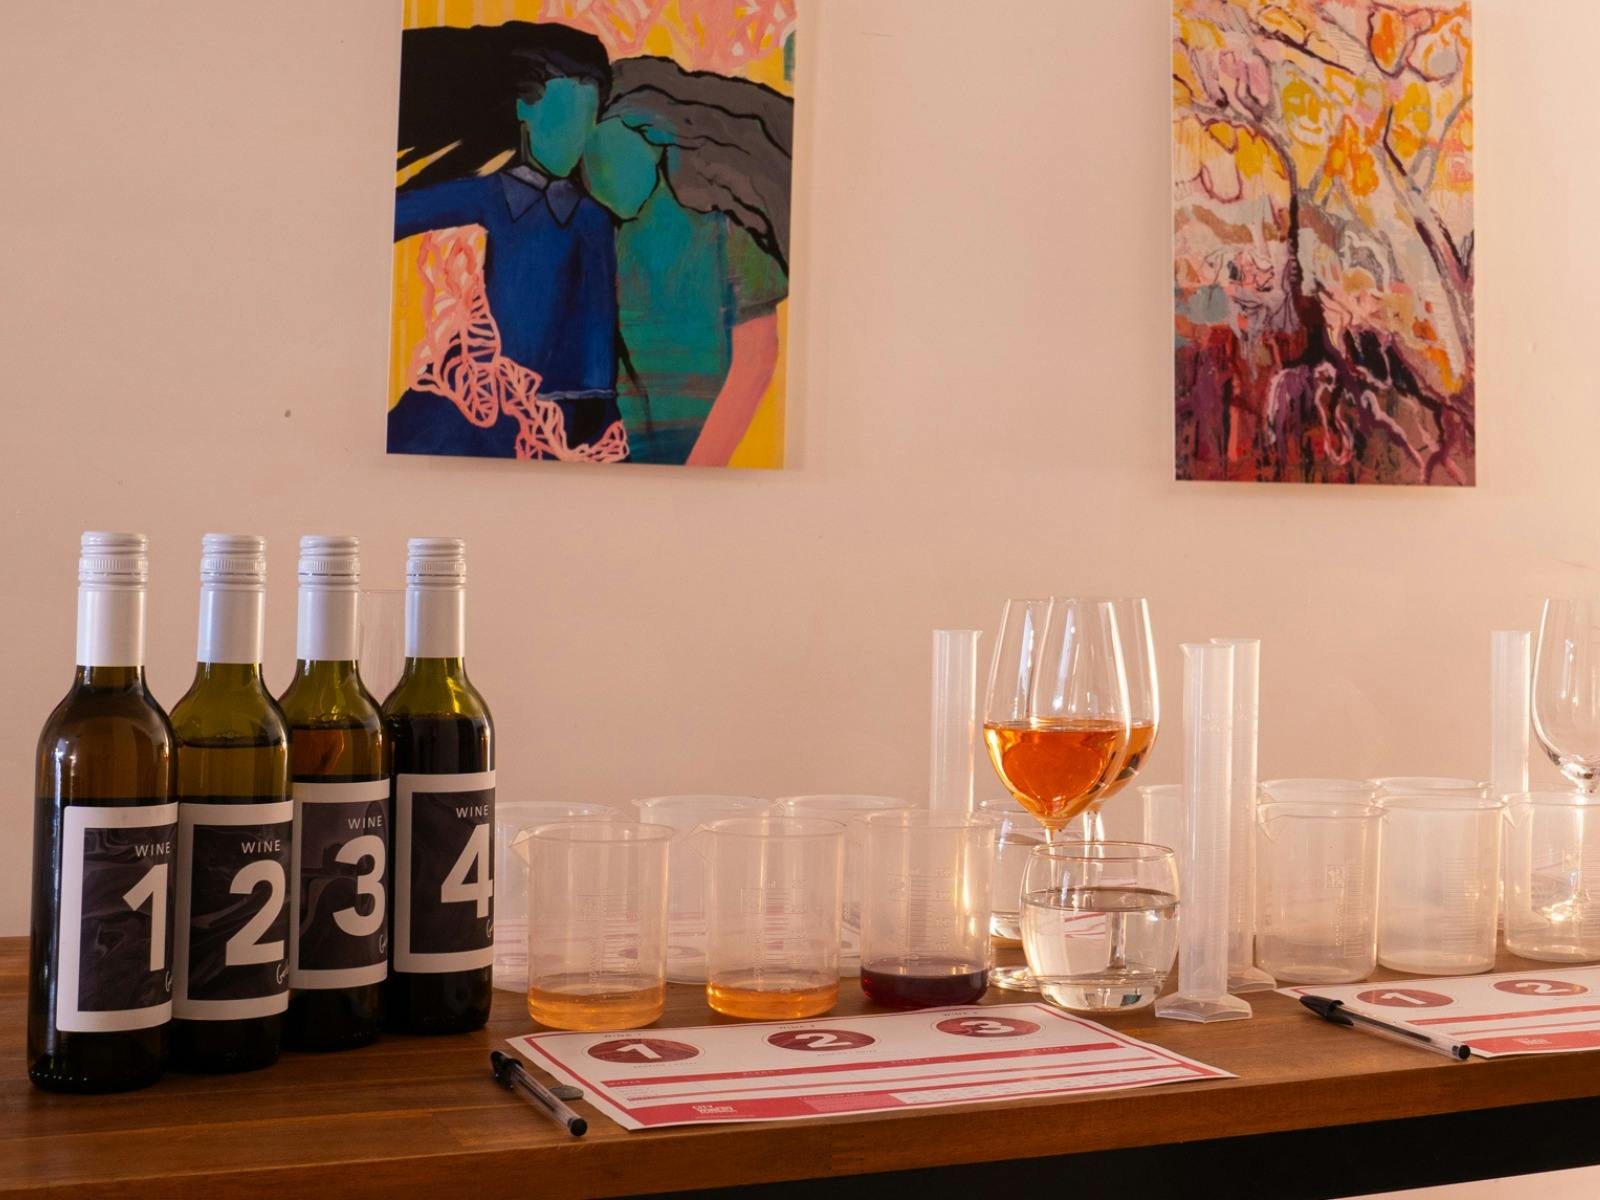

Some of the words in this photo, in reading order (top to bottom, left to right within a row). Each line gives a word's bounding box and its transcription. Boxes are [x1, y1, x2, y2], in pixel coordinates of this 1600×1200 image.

[455, 804, 489, 819] WINE
[347, 815, 383, 830] WINE
[135, 841, 171, 857] WINE
[241, 839, 281, 854] WINE
[440, 823, 494, 919] 4
[332, 834, 386, 937] 3
[122, 863, 168, 972] 1
[225, 859, 286, 967] 2
[1514, 982, 1569, 994] 2
[1380, 992, 1427, 1005] 1
[959, 1020, 1016, 1034] 3
[795, 1032, 854, 1049] 2
[615, 1043, 663, 1060] 1
